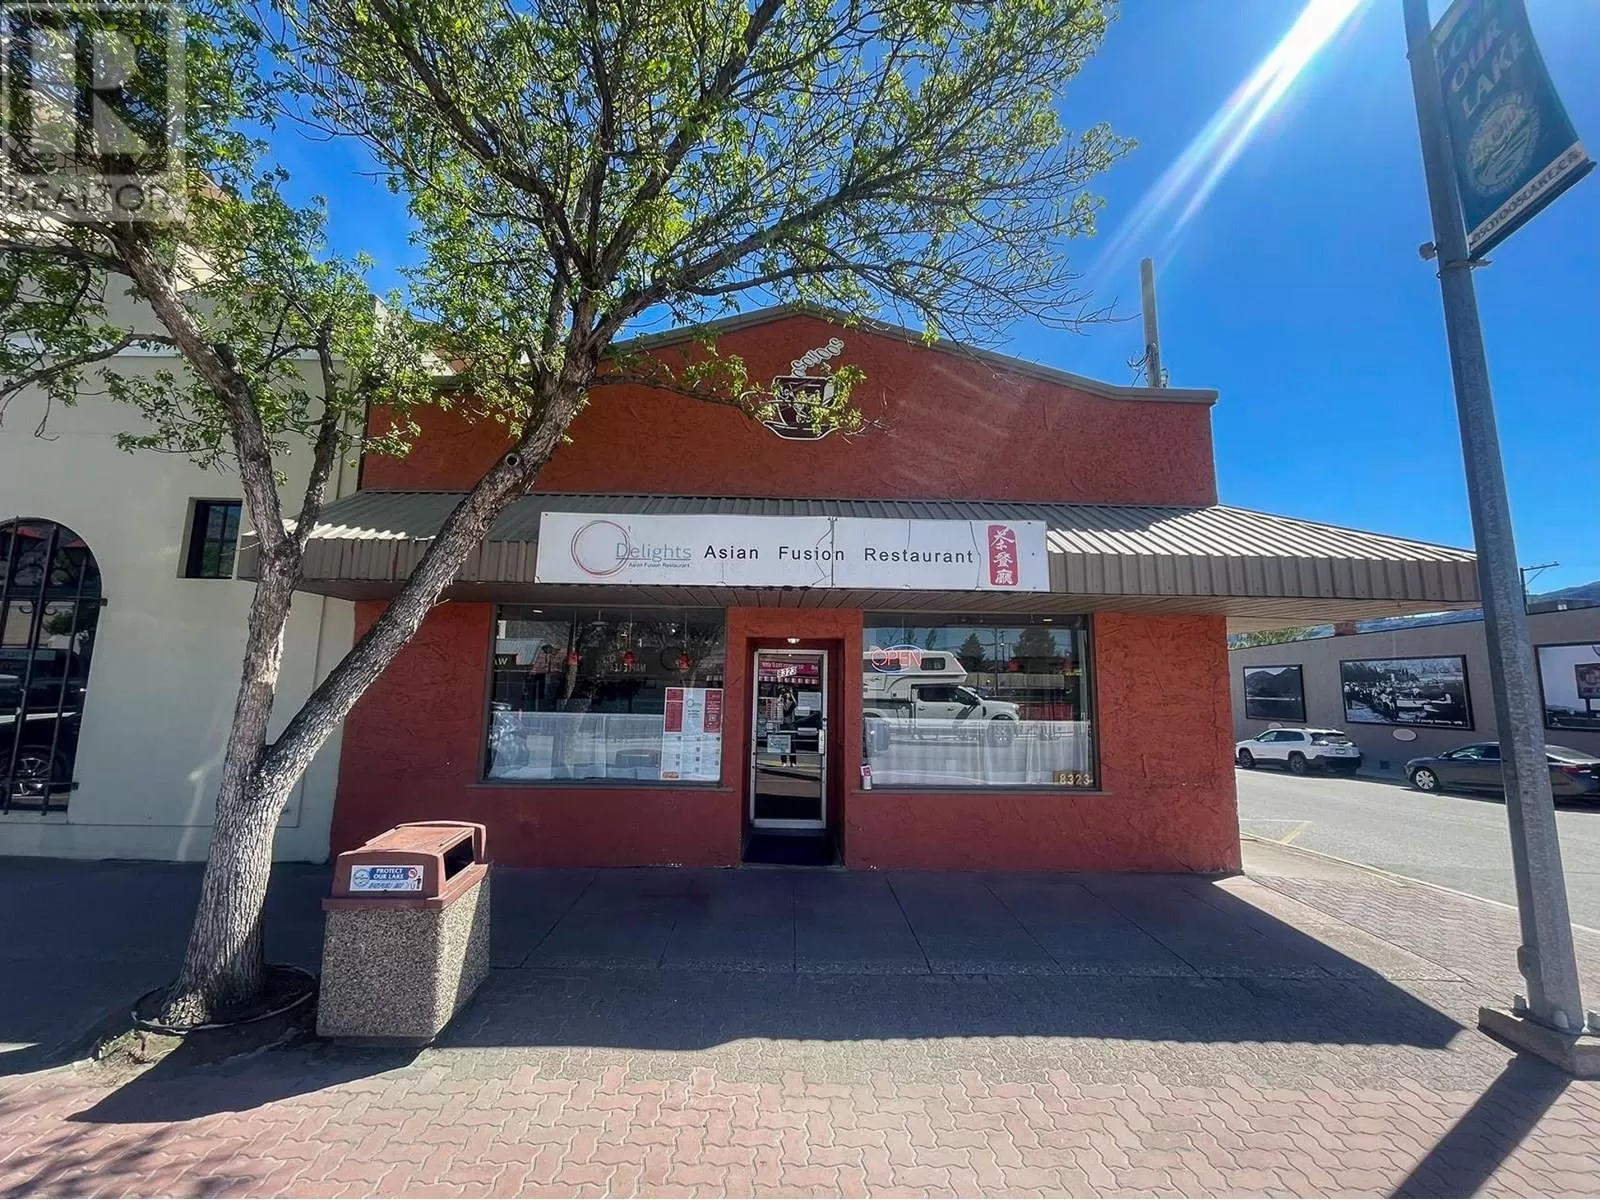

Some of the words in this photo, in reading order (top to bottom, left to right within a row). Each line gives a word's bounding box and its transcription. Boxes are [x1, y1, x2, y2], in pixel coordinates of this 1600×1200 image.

[1461, 32, 1524, 120] LAKE
[616, 542, 692, 562] Delights
[704, 545, 759, 559] Asian
[779, 546, 844, 561] Fusion
[865, 548, 973, 563] Restaurant
[872, 649, 921, 667] OPEN
[1060, 773, 1089, 785] 8323
